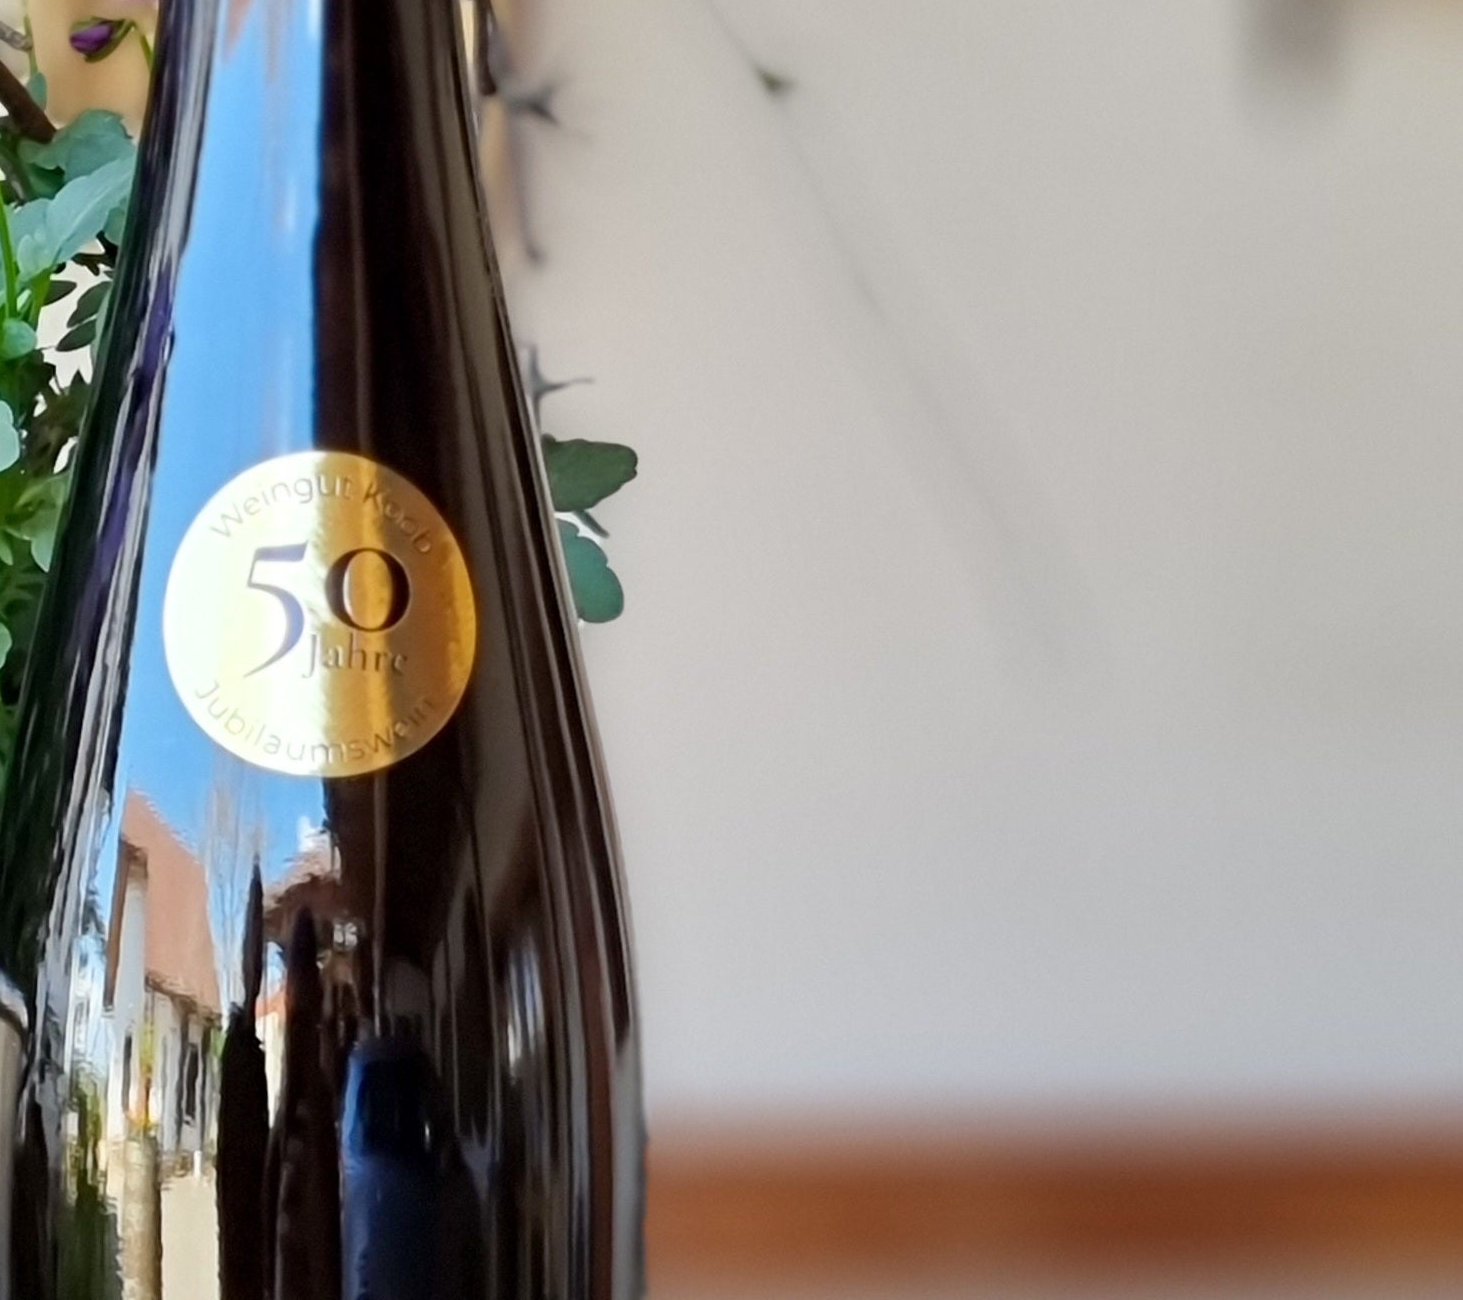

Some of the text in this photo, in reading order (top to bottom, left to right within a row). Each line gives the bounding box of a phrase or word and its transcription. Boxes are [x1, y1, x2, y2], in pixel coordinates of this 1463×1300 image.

[210, 475, 431, 553] Weingut Koob
[243, 541, 411, 678] 50
[301, 633, 408, 679] Jahre
